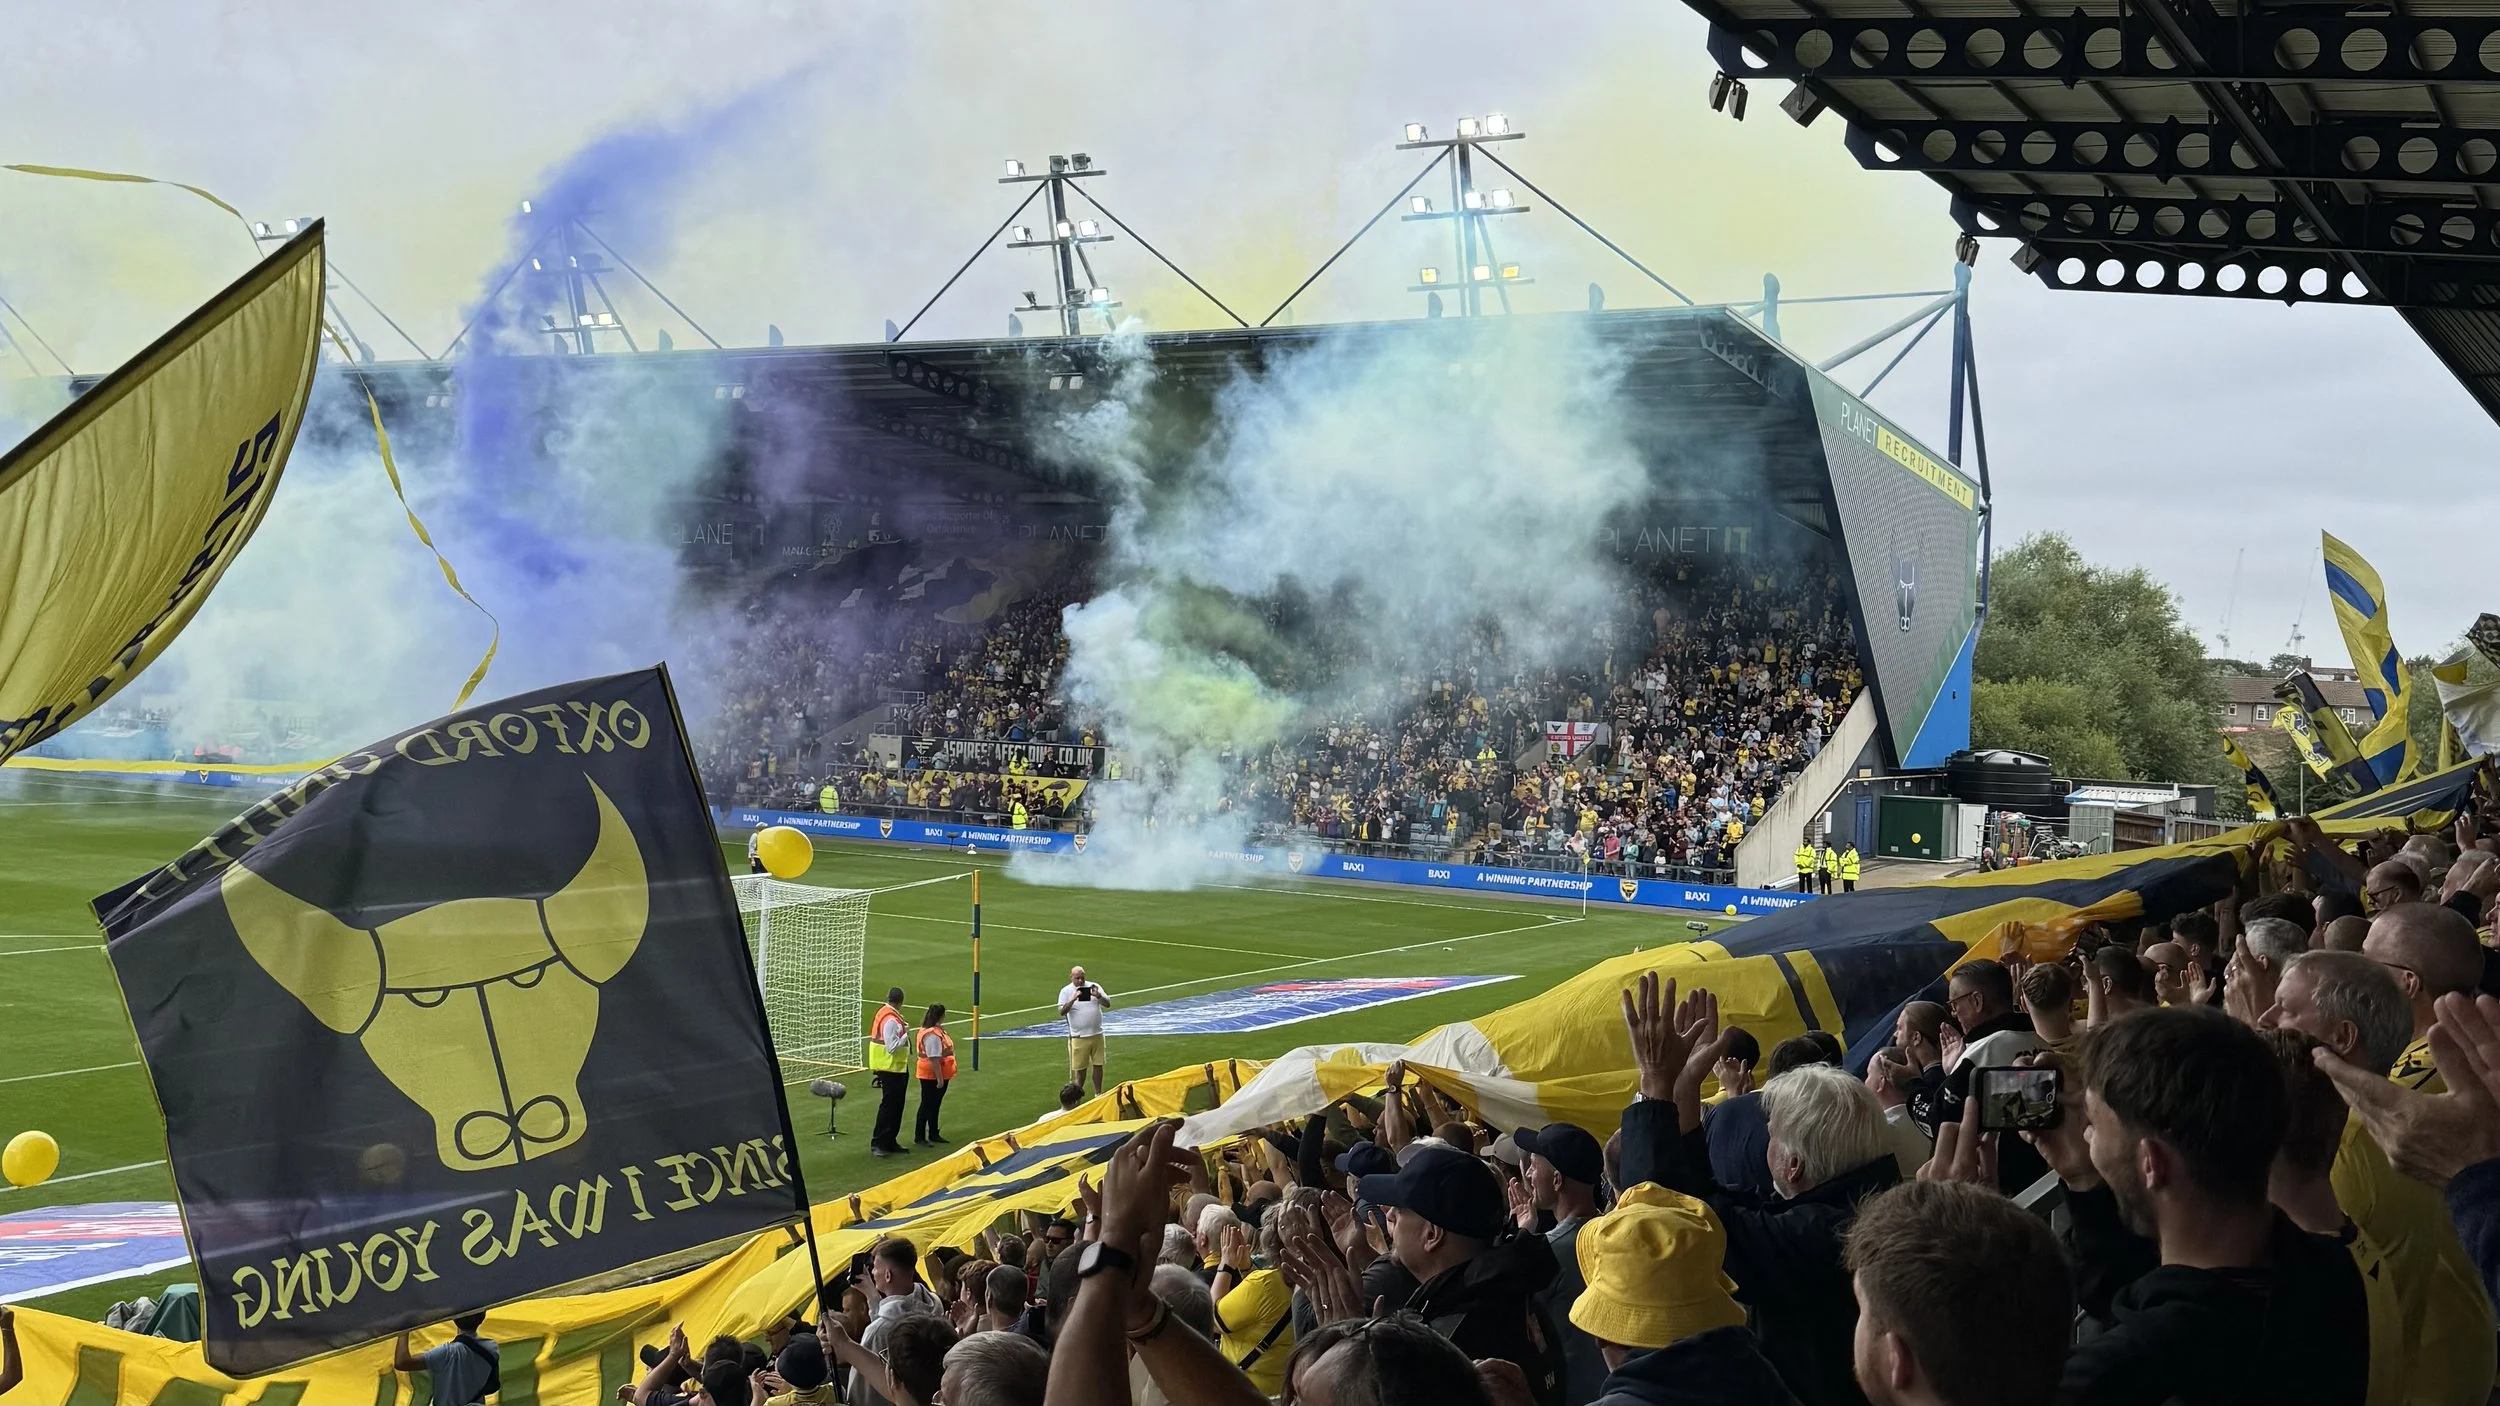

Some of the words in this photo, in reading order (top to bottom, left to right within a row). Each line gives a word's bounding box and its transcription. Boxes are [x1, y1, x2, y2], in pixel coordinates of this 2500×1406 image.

[1840, 402, 1878, 447] PLANET
[1885, 434, 1968, 502] RECRUITMENT
[1724, 526, 1752, 553] IT
[743, 814, 759, 822] BAXI
[777, 817, 783, 825] A
[783, 817, 813, 827] WINNING
[813, 819, 861, 830] PARTNERSHIP
[925, 828, 942, 837] BAXI
[961, 830, 967, 839] A
[968, 831, 1000, 842] WINNING
[1000, 834, 1052, 845] PARTNERSHIP
[1343, 861, 1364, 872] BAXI
[1428, 869, 1450, 879] BAXI
[1476, 872, 1484, 882] A
[1485, 873, 1527, 885] WINNING
[1527, 876, 1593, 891] PARTNERSHIP
[1685, 891, 1711, 903] BAXI
[1740, 895, 1748, 905] A
